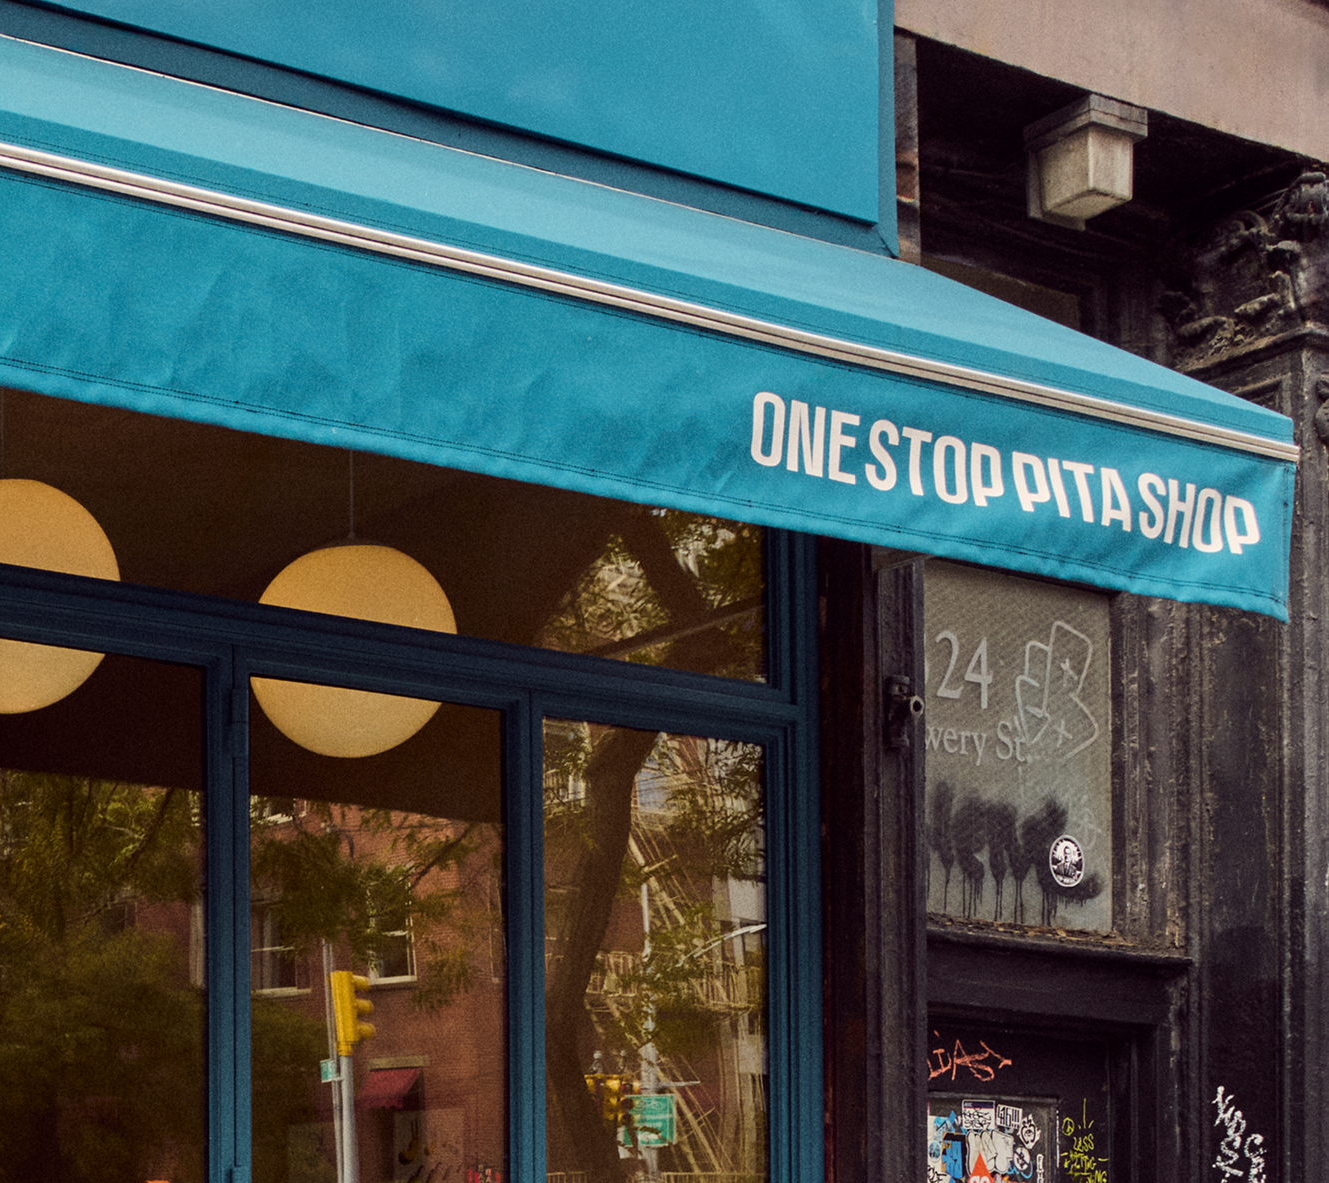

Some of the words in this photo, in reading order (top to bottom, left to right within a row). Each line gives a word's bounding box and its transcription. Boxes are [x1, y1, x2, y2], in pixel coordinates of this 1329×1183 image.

[750, 391, 861, 485] ONE
[864, 418, 1005, 507] STOP
[1011, 450, 1133, 532] PITA
[1138, 472, 1262, 555] SHOP
[925, 630, 993, 709] 24
